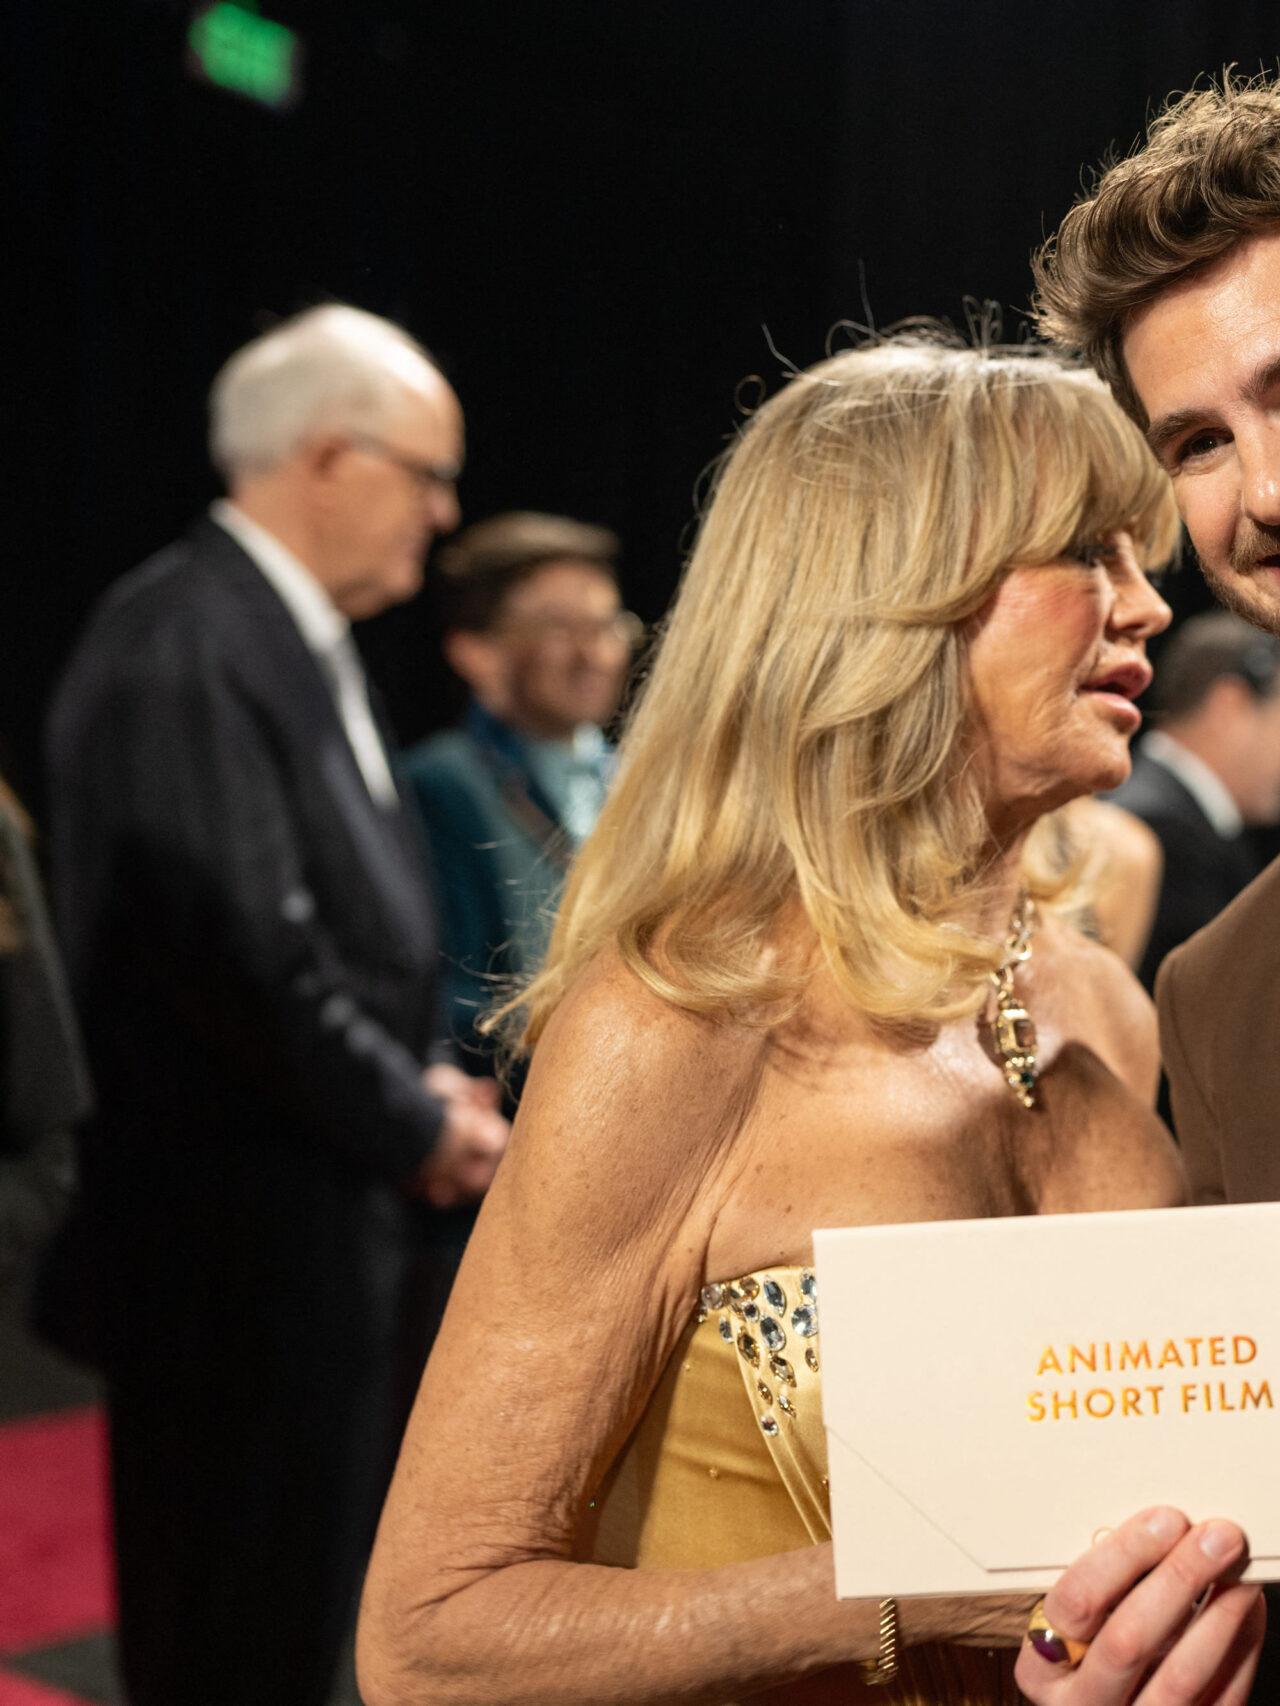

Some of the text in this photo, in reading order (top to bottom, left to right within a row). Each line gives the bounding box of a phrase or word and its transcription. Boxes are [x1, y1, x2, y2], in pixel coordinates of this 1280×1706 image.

[1035, 1333, 1259, 1377] ANIMATED
[1024, 1378, 1275, 1423] SHORT FILM
